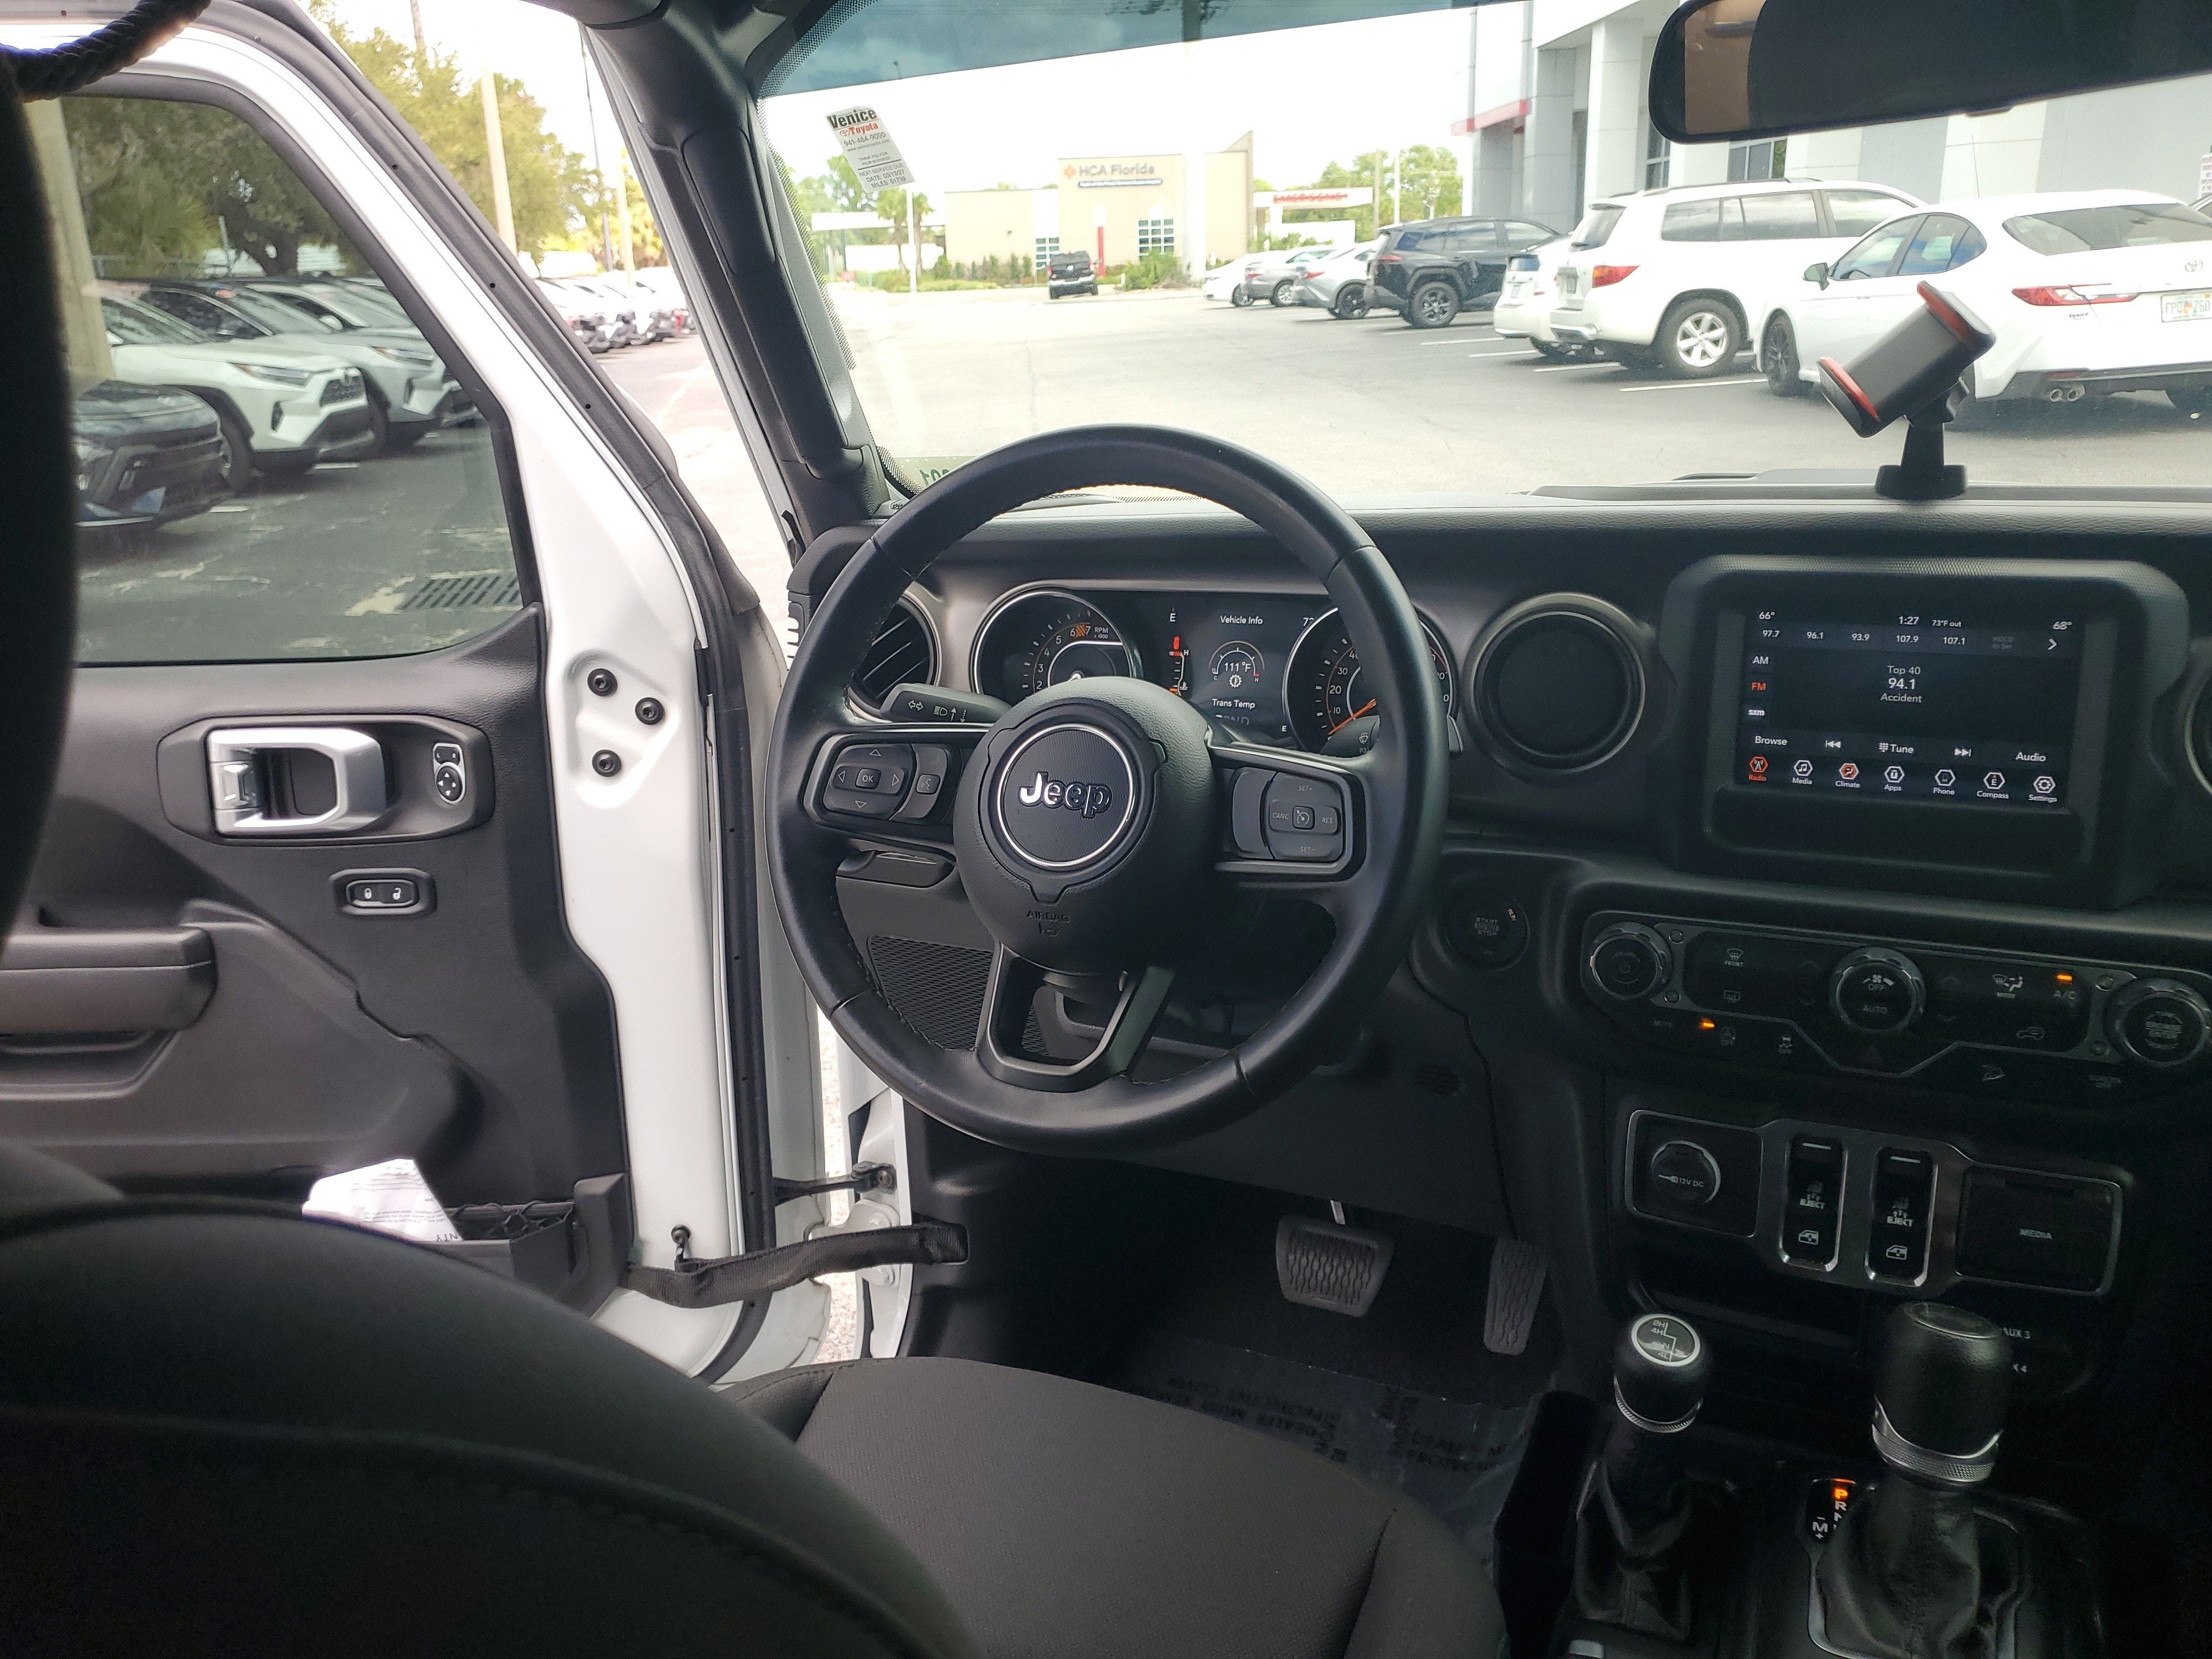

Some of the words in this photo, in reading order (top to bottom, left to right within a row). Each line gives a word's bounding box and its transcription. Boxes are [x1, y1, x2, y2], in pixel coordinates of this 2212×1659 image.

[827, 109, 877, 128] Venice
[849, 123, 879, 135] Toyota
[844, 132, 886, 146] 941-484-9000
[1079, 164, 1107, 176] HCA
[1110, 162, 1155, 175] Florida
[1169, 613, 1176, 622] E
[1220, 615, 1247, 624] Vehicle
[1248, 616, 1263, 625] Info
[1898, 616, 1920, 625] 1:27
[1070, 628, 1075, 637] 6
[1085, 625, 1091, 635] 7
[1762, 630, 1780, 638] 97.7
[1056, 635, 1062, 645] 5
[1807, 631, 1824, 640] 96.1
[1852, 633, 1870, 641] 93.9
[1896, 635, 1919, 643] 107.9
[1943, 636, 1966, 645] 107.1
[1044, 647, 1050, 657] 4
[1752, 656, 1769, 664] AM
[1037, 663, 1044, 673] 3
[1224, 662, 1240, 672] 111
[1337, 667, 1348, 675] 30
[1888, 665, 1905, 678] Top
[1906, 665, 1921, 675] 40
[1036, 680, 1043, 690] 2
[1751, 682, 1767, 691] FM
[1888, 678, 1916, 690] 94.1
[1329, 685, 1342, 695] 20
[1880, 693, 1922, 703] Accident
[1212, 698, 1232, 707] Trans
[1234, 699, 1256, 710] Temp
[1755, 735, 1788, 746] Browse
[1889, 743, 1914, 754] Tune
[2016, 752, 2046, 763] Audio
[862, 774, 874, 783] OK
[1792, 777, 1813, 785] Media
[1835, 780, 1860, 789] Climate
[1884, 784, 1902, 793] Apps
[1019, 771, 1112, 819] Jeep
[1933, 787, 1955, 795] Phone
[1977, 791, 2009, 799] Compass
[1027, 910, 1070, 923] AIRBAG
[2053, 989, 2076, 1000] A/C
[1799, 1198, 1826, 1210] EJECT
[1886, 1215, 1915, 1227] EJECT
[2019, 1228, 2052, 1240] MEDIA
[1651, 1327, 1663, 1335] 4H
[1834, 1488, 1848, 1499] P
[1834, 1500, 1847, 1511] R
[1812, 1521, 1829, 1533] M
